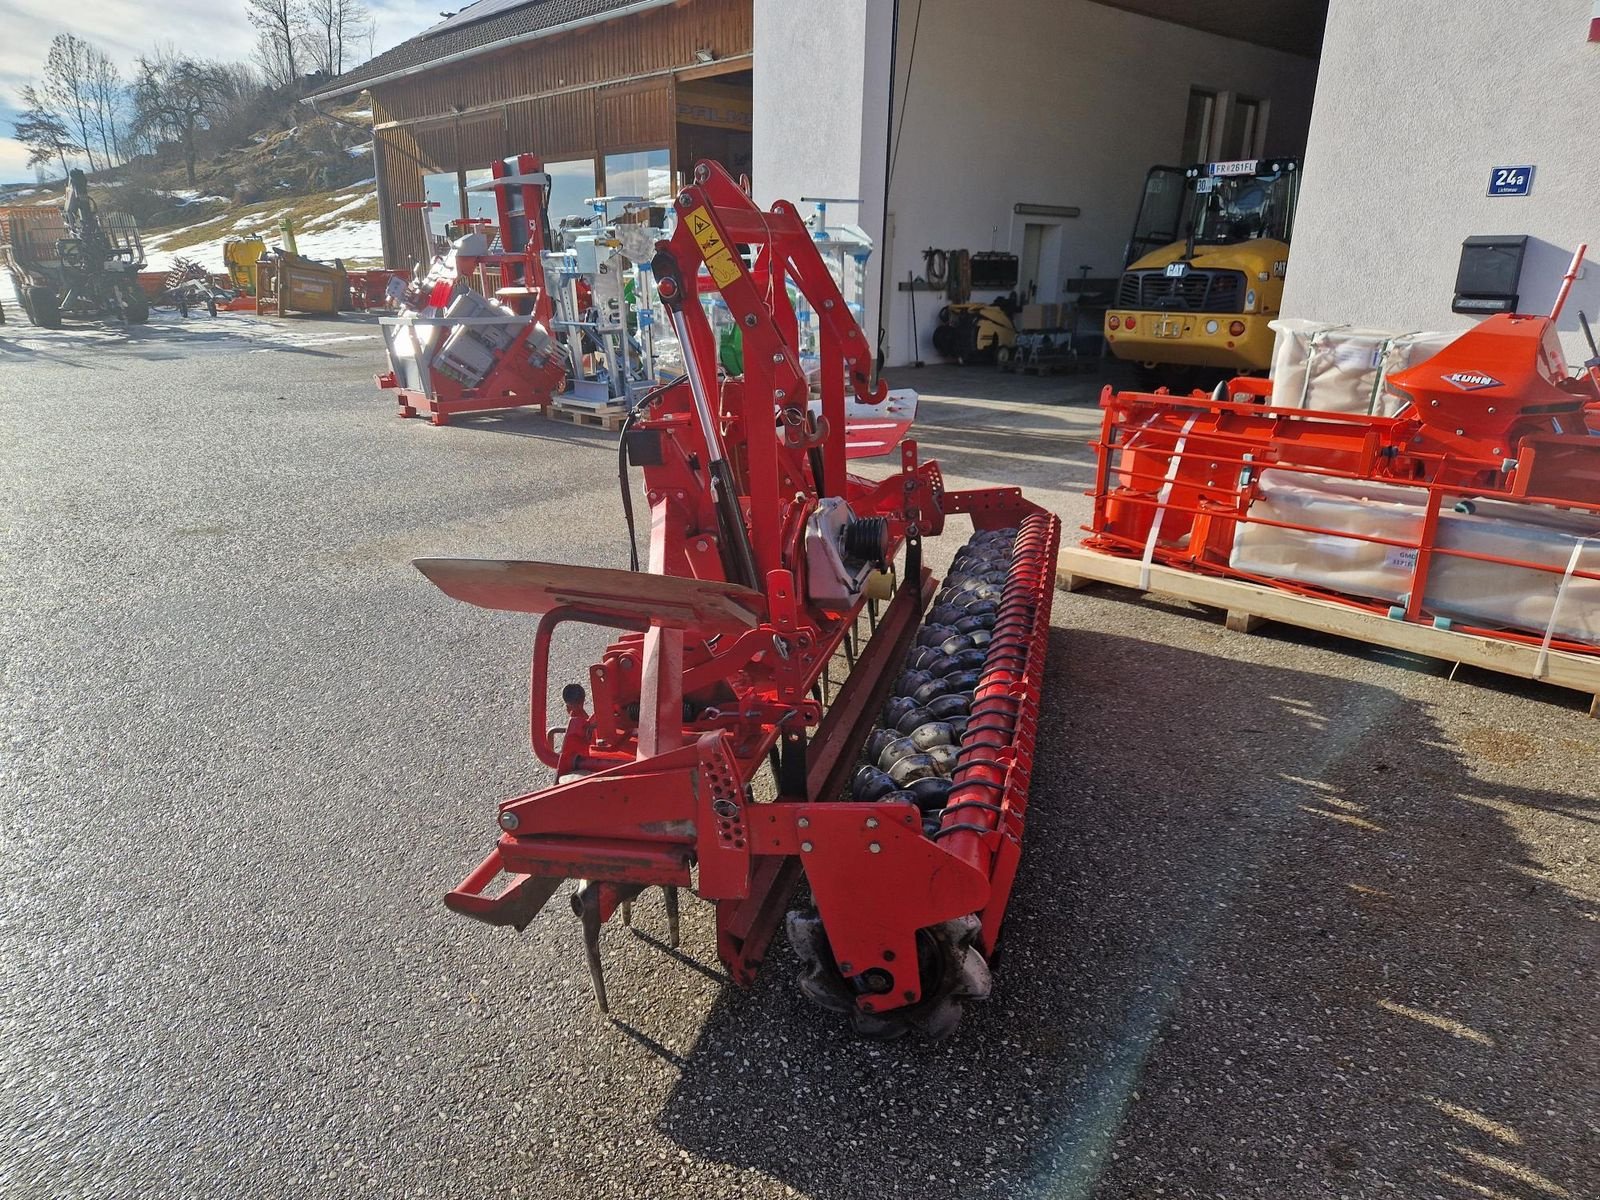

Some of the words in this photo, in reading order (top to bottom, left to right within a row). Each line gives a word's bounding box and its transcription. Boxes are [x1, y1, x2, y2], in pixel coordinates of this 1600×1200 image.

[1216, 164, 1226, 173] FR
[1231, 162, 1254, 173] 261FL
[1495, 169, 1524, 186] 24a
[1166, 263, 1186, 277] CAT
[1451, 373, 1493, 386] KUHN
